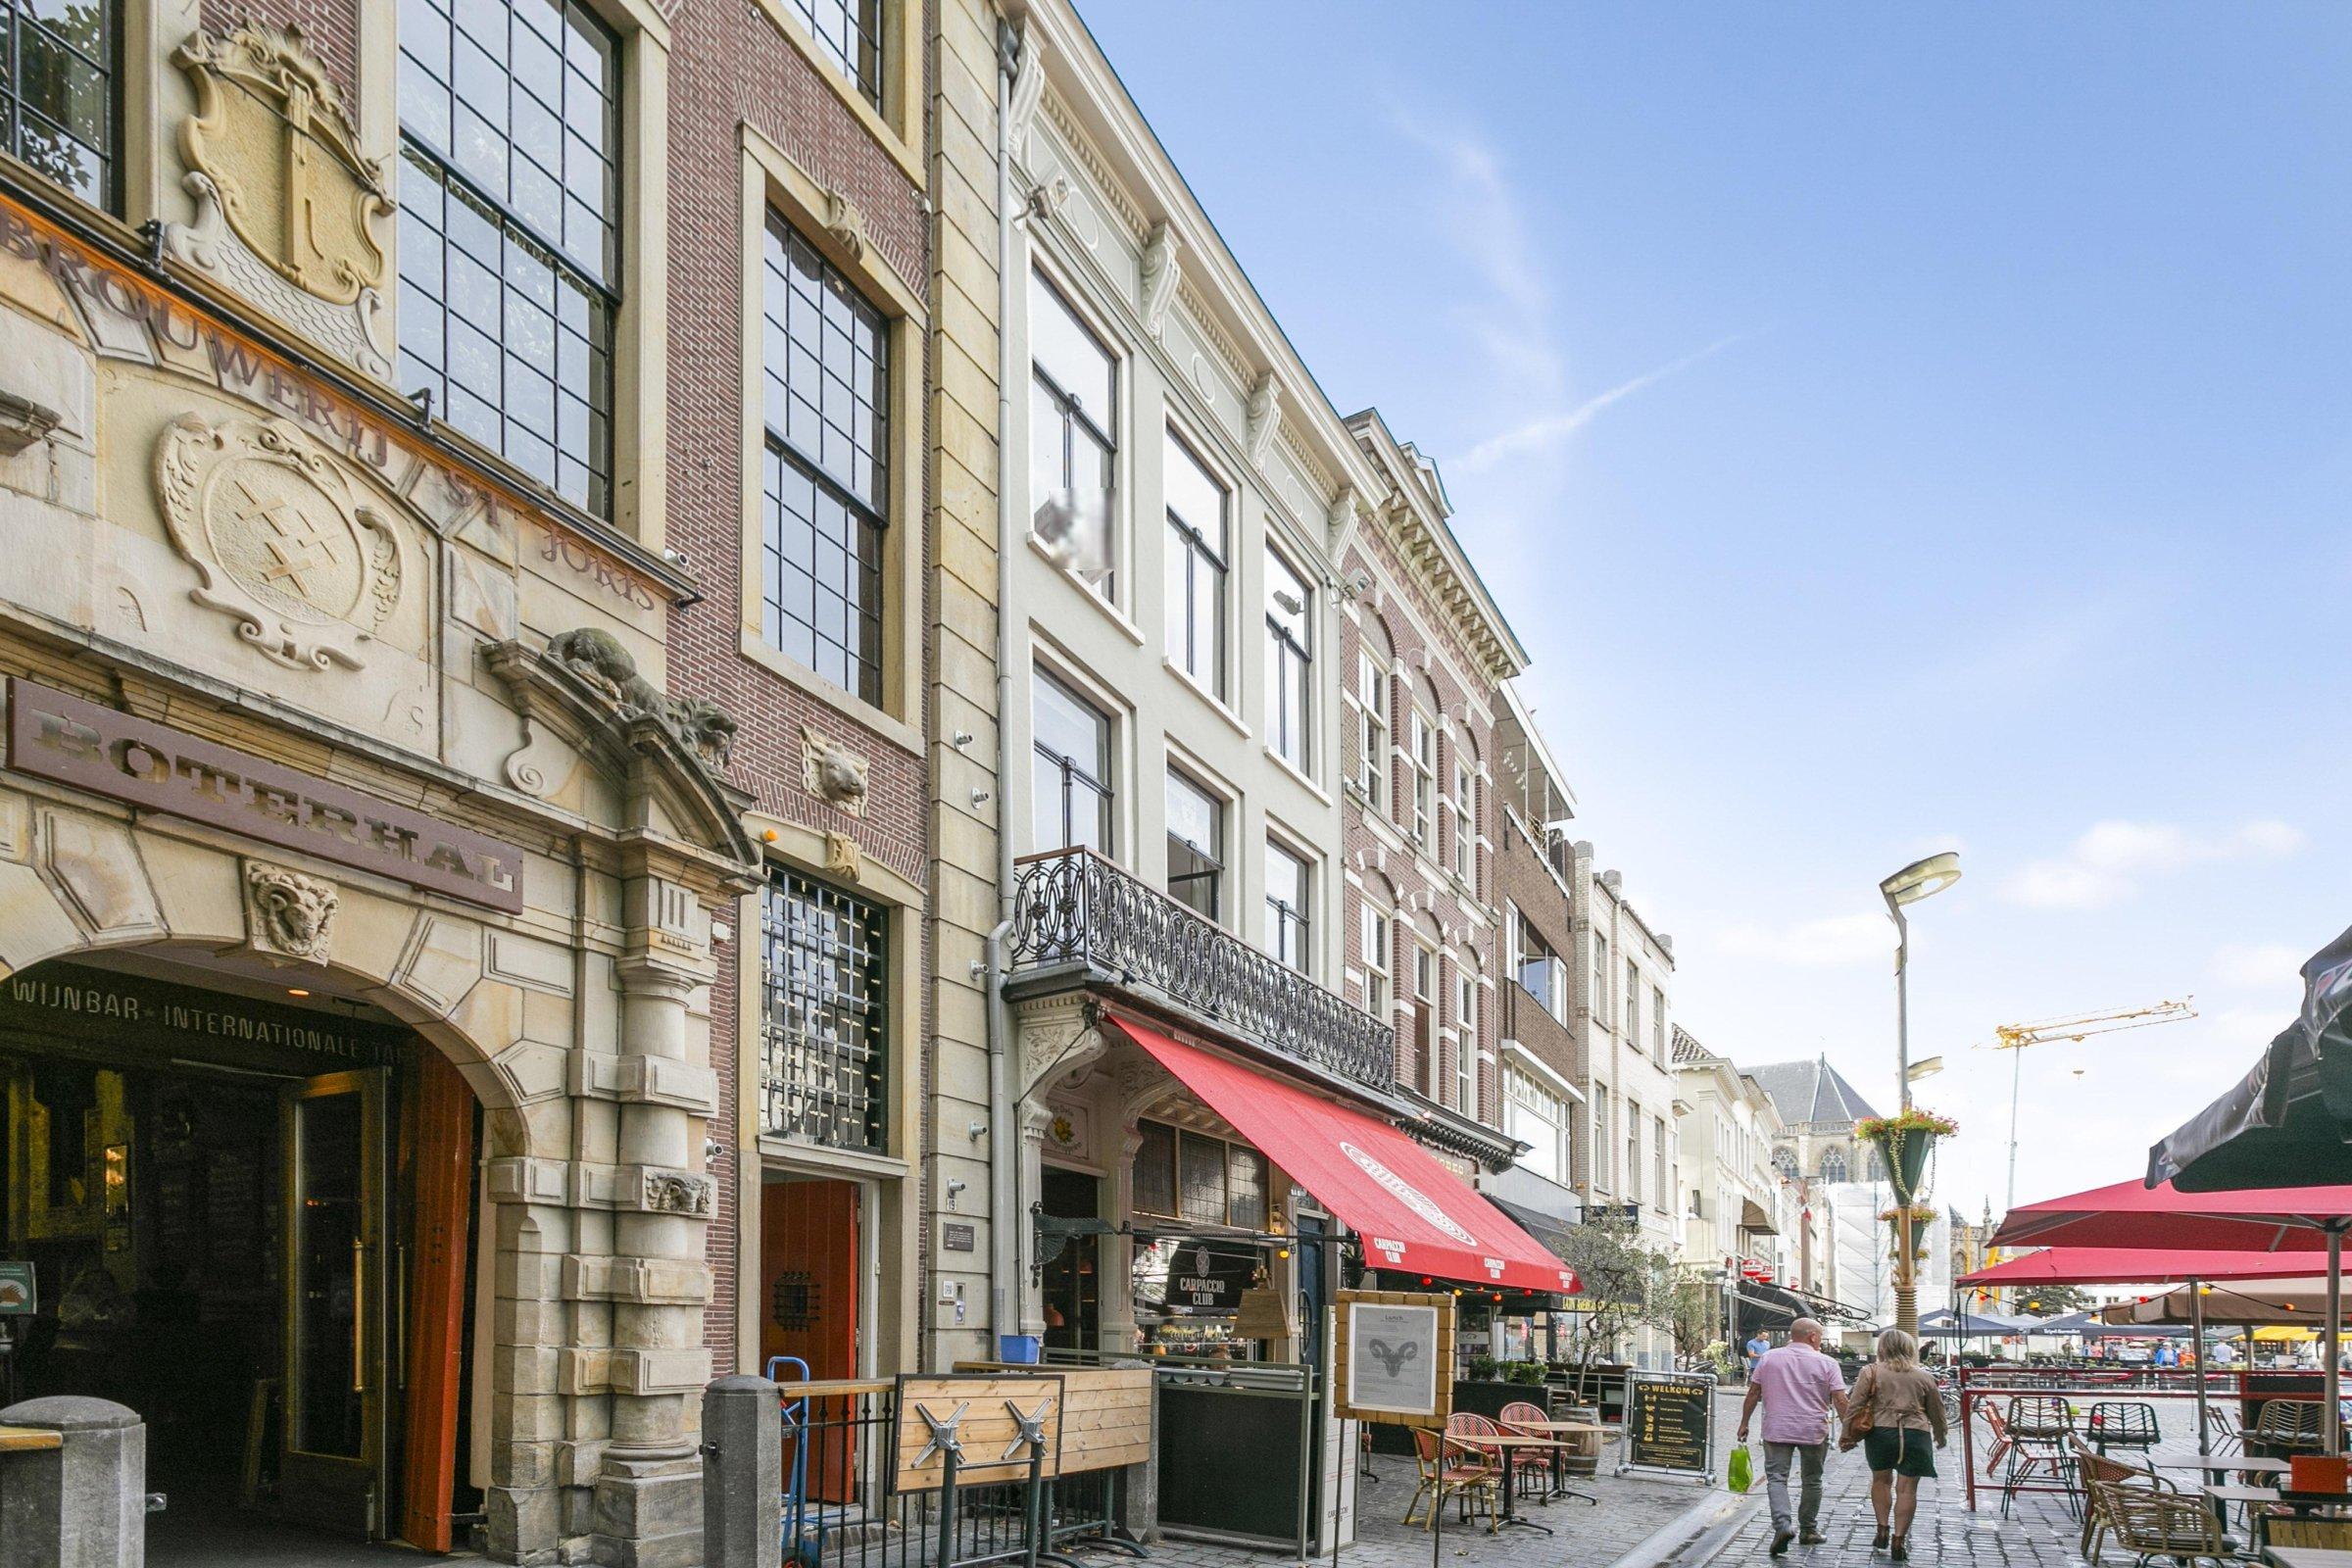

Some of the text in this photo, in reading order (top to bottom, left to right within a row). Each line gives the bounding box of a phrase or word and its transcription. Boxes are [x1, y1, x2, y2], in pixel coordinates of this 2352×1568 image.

[0, 206, 388, 467] BROUWERIJ
[541, 522, 655, 611] JORIS
[29, 708, 514, 893] BOTERHAL
[13, 978, 139, 1020] WIJNBAR
[165, 1005, 360, 1058] INTERNATIONALE
[949, 1200, 956, 1210] 19
[1180, 1277, 1225, 1294] CARPACCIO
[1193, 1293, 1214, 1305] CLUB
[1651, 1385, 1690, 1395] WELKOM
